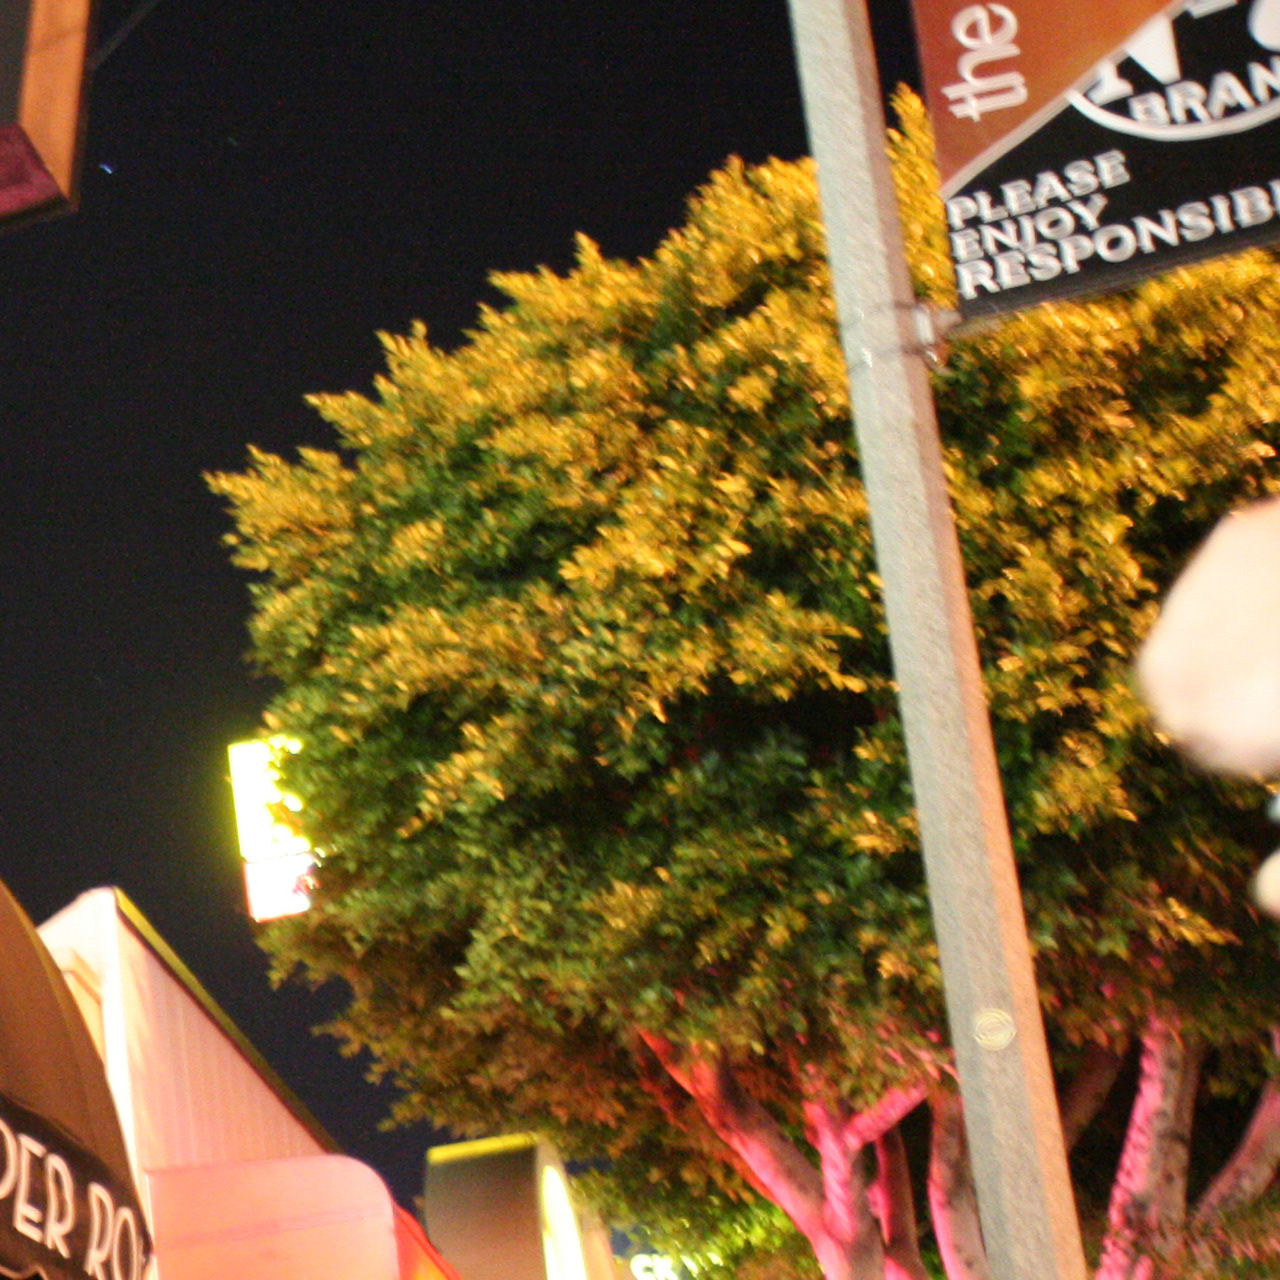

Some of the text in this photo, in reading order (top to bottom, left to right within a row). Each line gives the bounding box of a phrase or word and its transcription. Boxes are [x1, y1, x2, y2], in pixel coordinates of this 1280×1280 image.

[942, 3, 1028, 122] the
[945, 149, 1131, 231] PLEASE
[949, 193, 1108, 263] ENJOY
